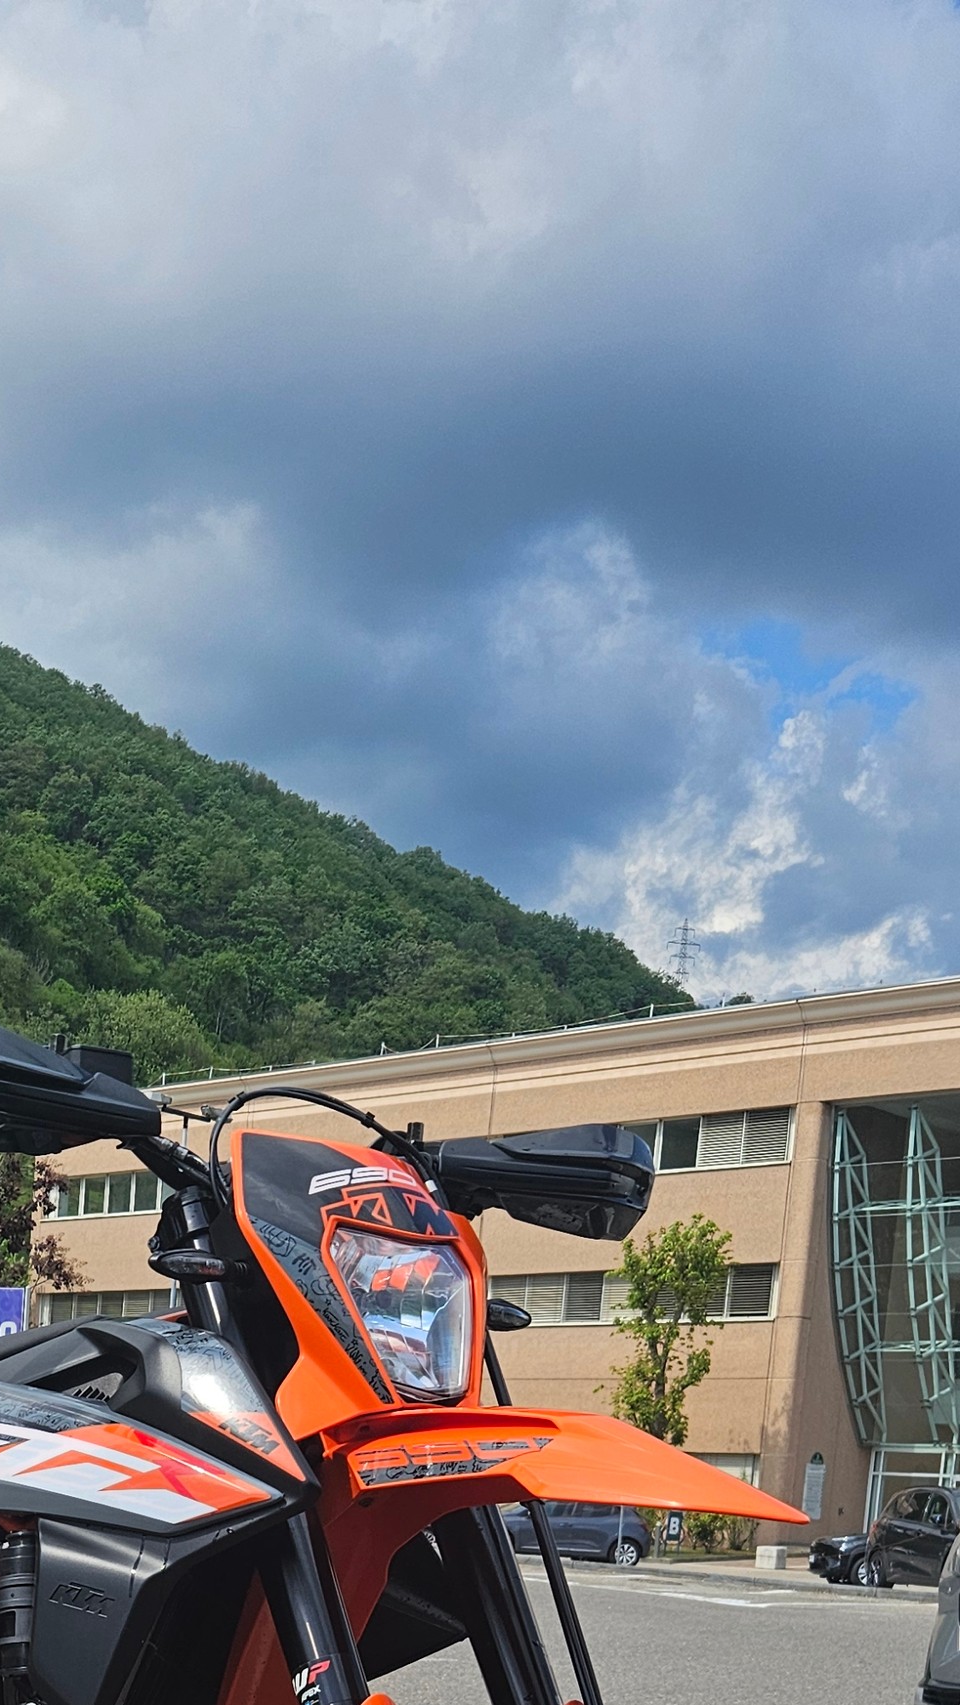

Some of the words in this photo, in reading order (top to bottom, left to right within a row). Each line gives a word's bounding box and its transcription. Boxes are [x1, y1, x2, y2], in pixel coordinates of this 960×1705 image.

[308, 1166, 417, 1195] 690
[218, 1417, 280, 1455] KTM
[668, 1516, 681, 1536] B
[292, 1660, 331, 1697] WP
